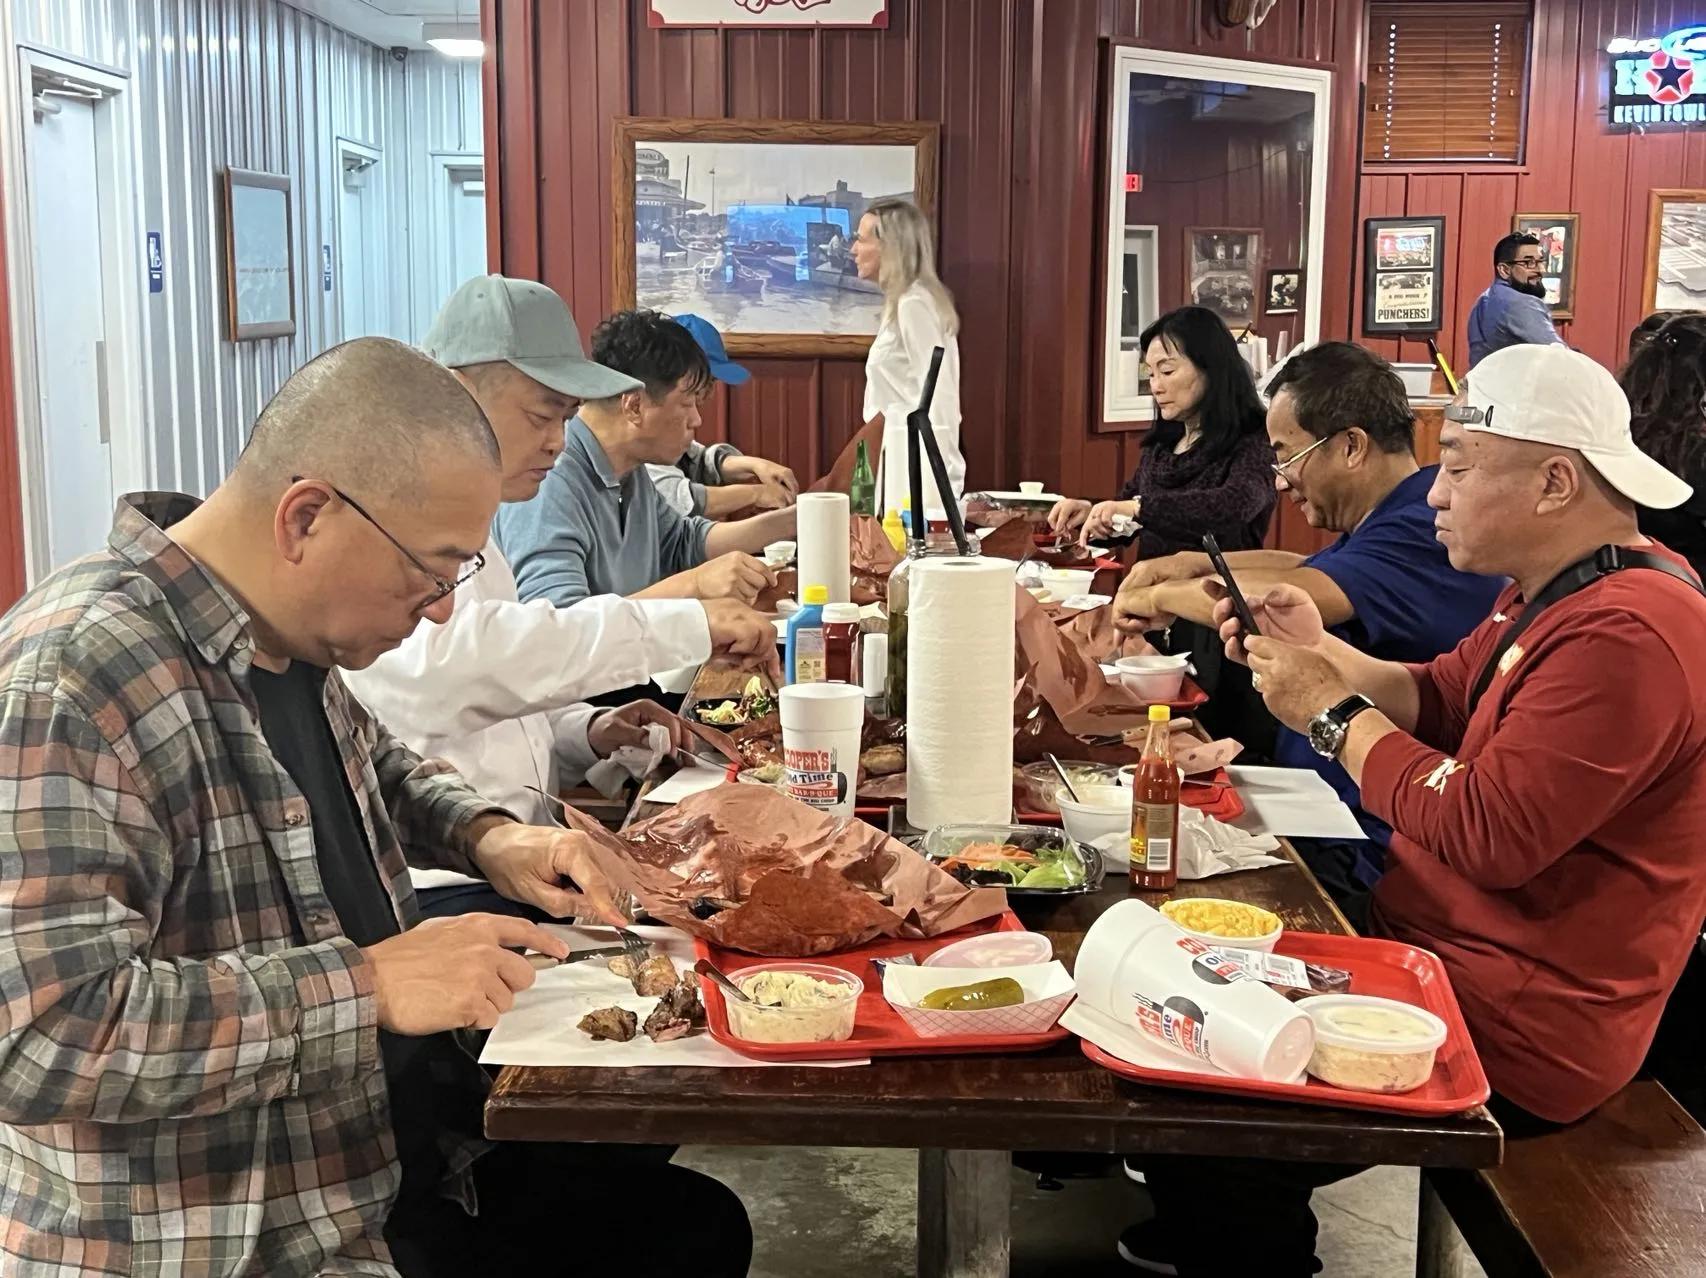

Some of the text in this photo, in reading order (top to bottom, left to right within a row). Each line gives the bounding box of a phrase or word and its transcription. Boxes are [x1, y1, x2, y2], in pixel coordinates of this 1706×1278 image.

[1614, 103, 1706, 123] KEVIN FOWL
[799, 772, 833, 784] Time
